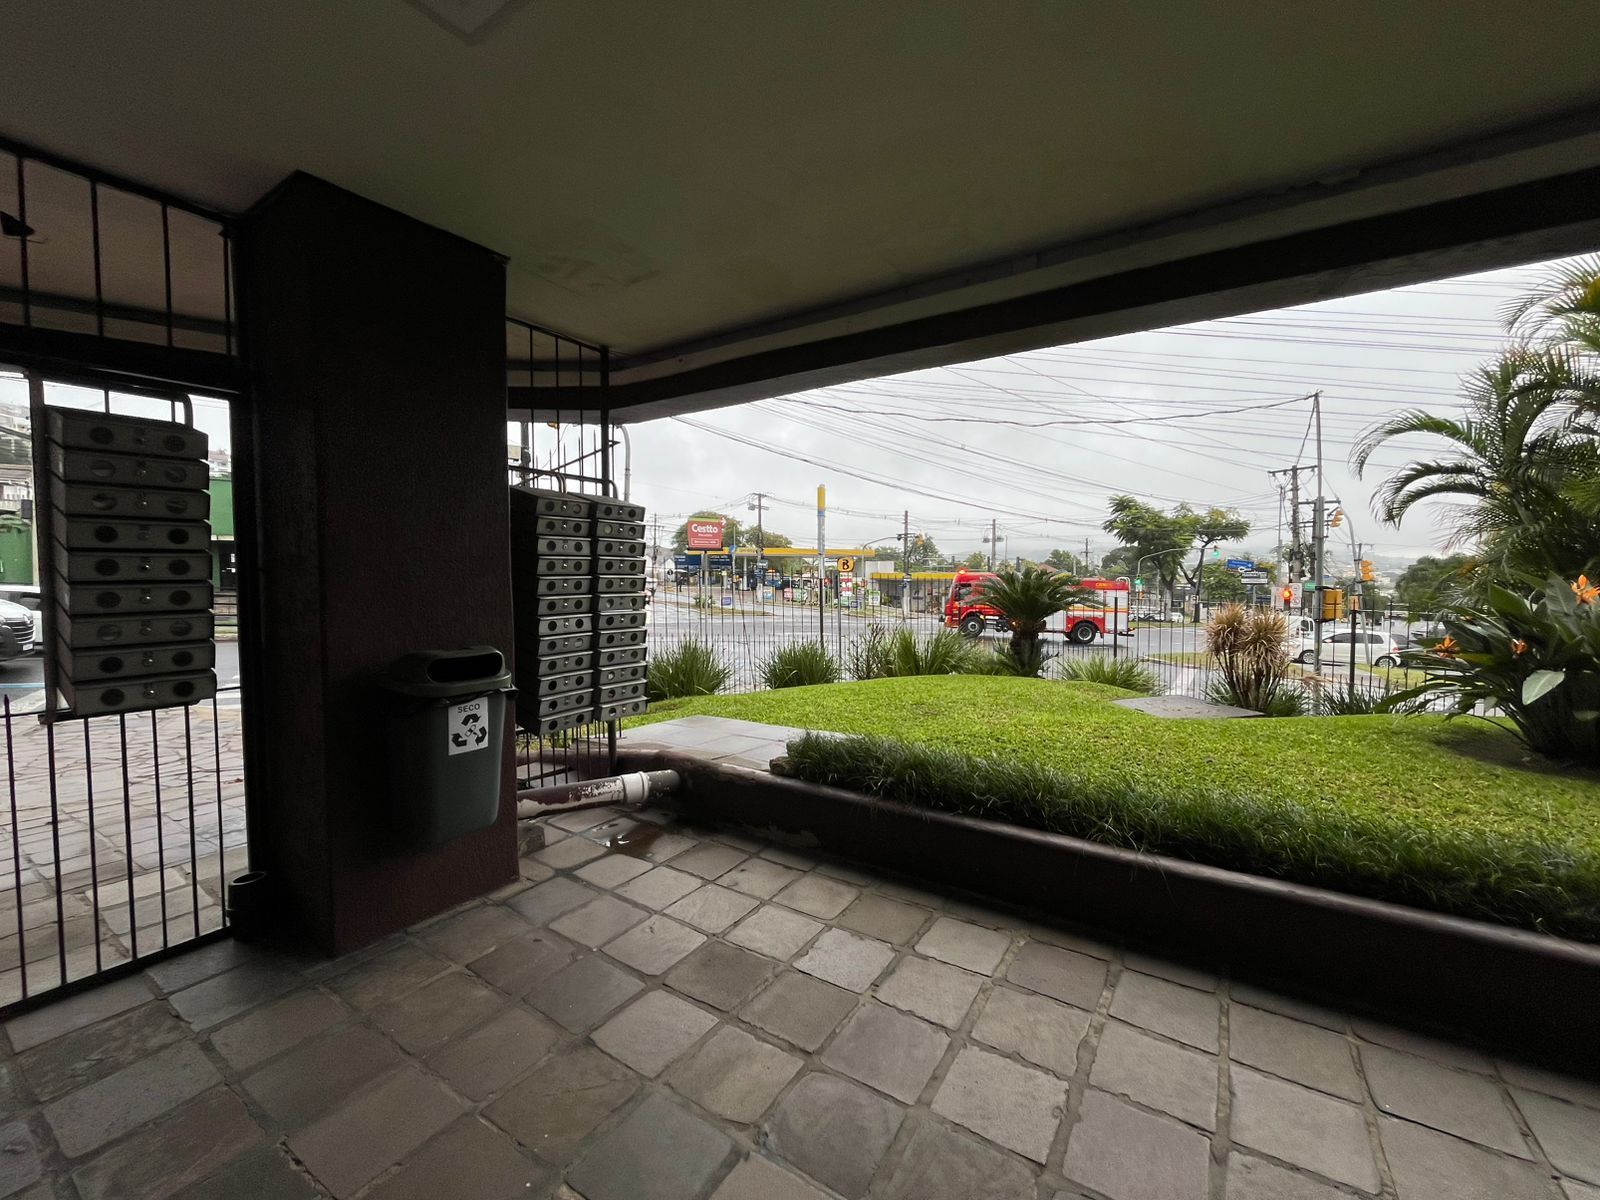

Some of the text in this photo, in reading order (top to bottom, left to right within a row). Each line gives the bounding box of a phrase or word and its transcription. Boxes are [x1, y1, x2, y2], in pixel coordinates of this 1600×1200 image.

[691, 523, 719, 534] Cestto
[842, 559, 850, 570] B
[457, 703, 481, 714] SECO
